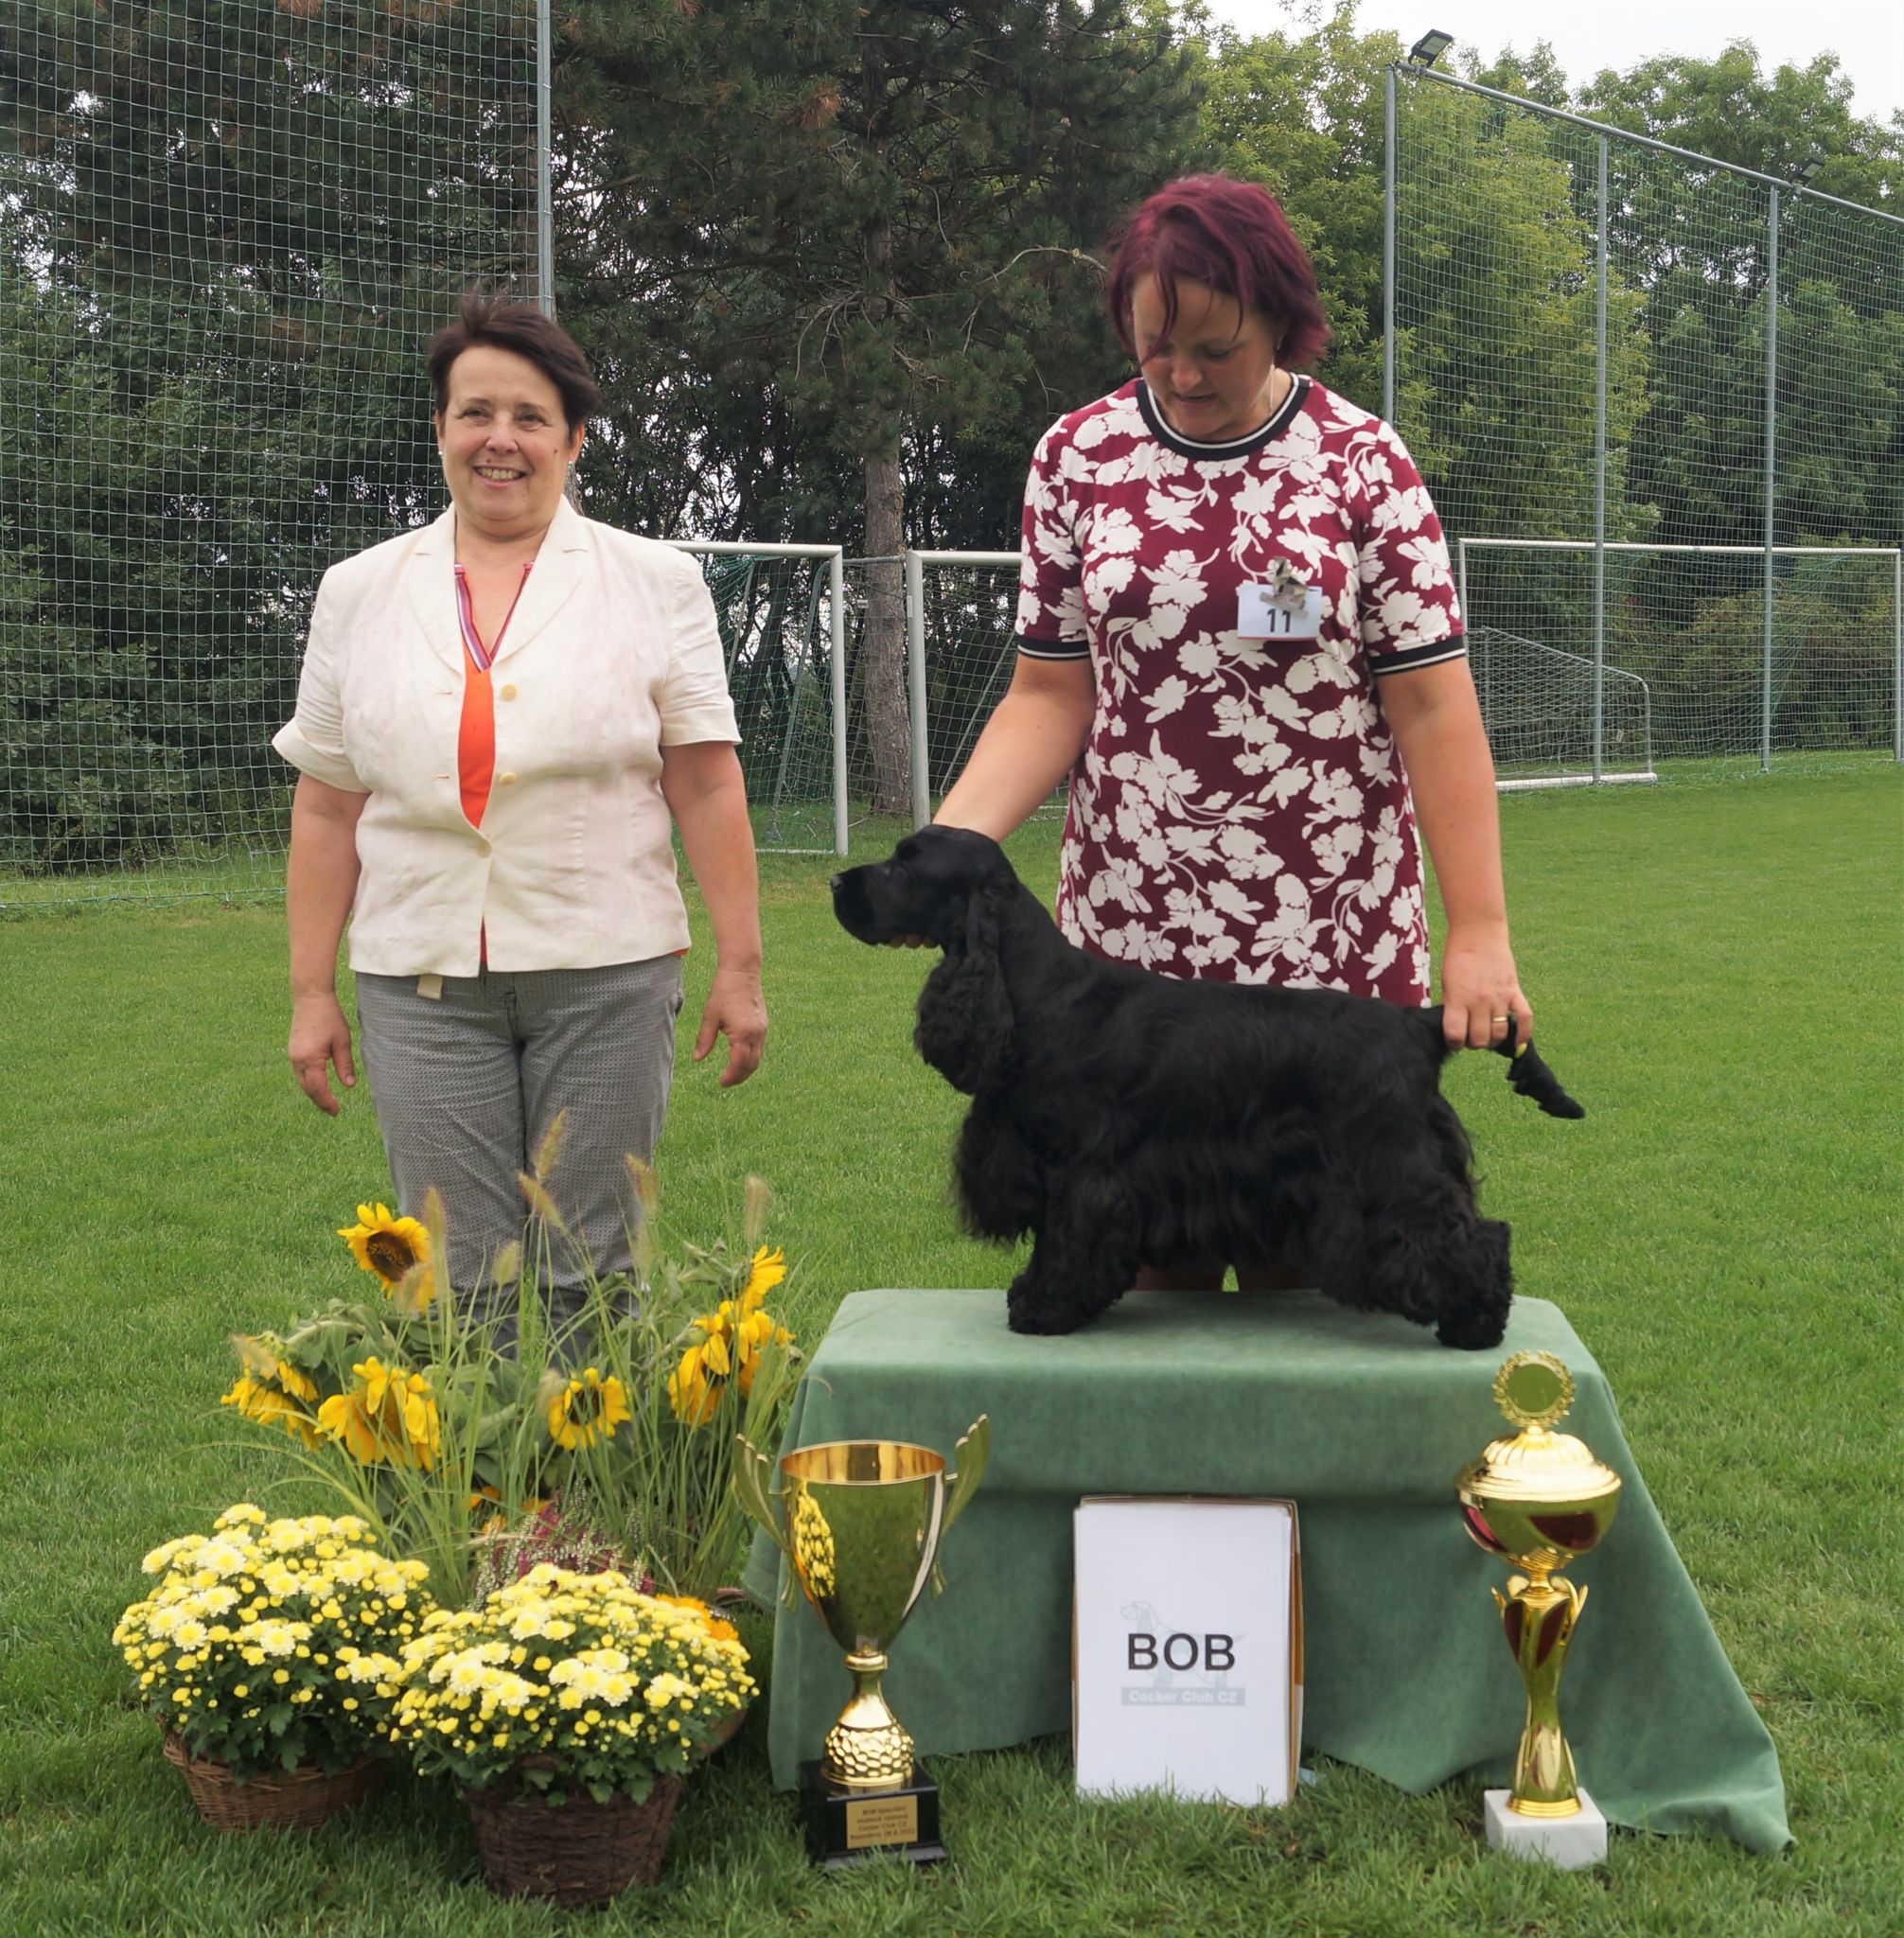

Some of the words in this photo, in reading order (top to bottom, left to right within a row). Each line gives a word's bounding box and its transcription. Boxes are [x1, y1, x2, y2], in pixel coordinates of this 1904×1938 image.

[1267, 608, 1291, 632] 11
[1128, 1632, 1236, 1671] BOB
[1129, 1690, 1177, 1703] Cocker
[1181, 1690, 1213, 1703] Club
[1218, 1690, 1237, 1703] CZ
